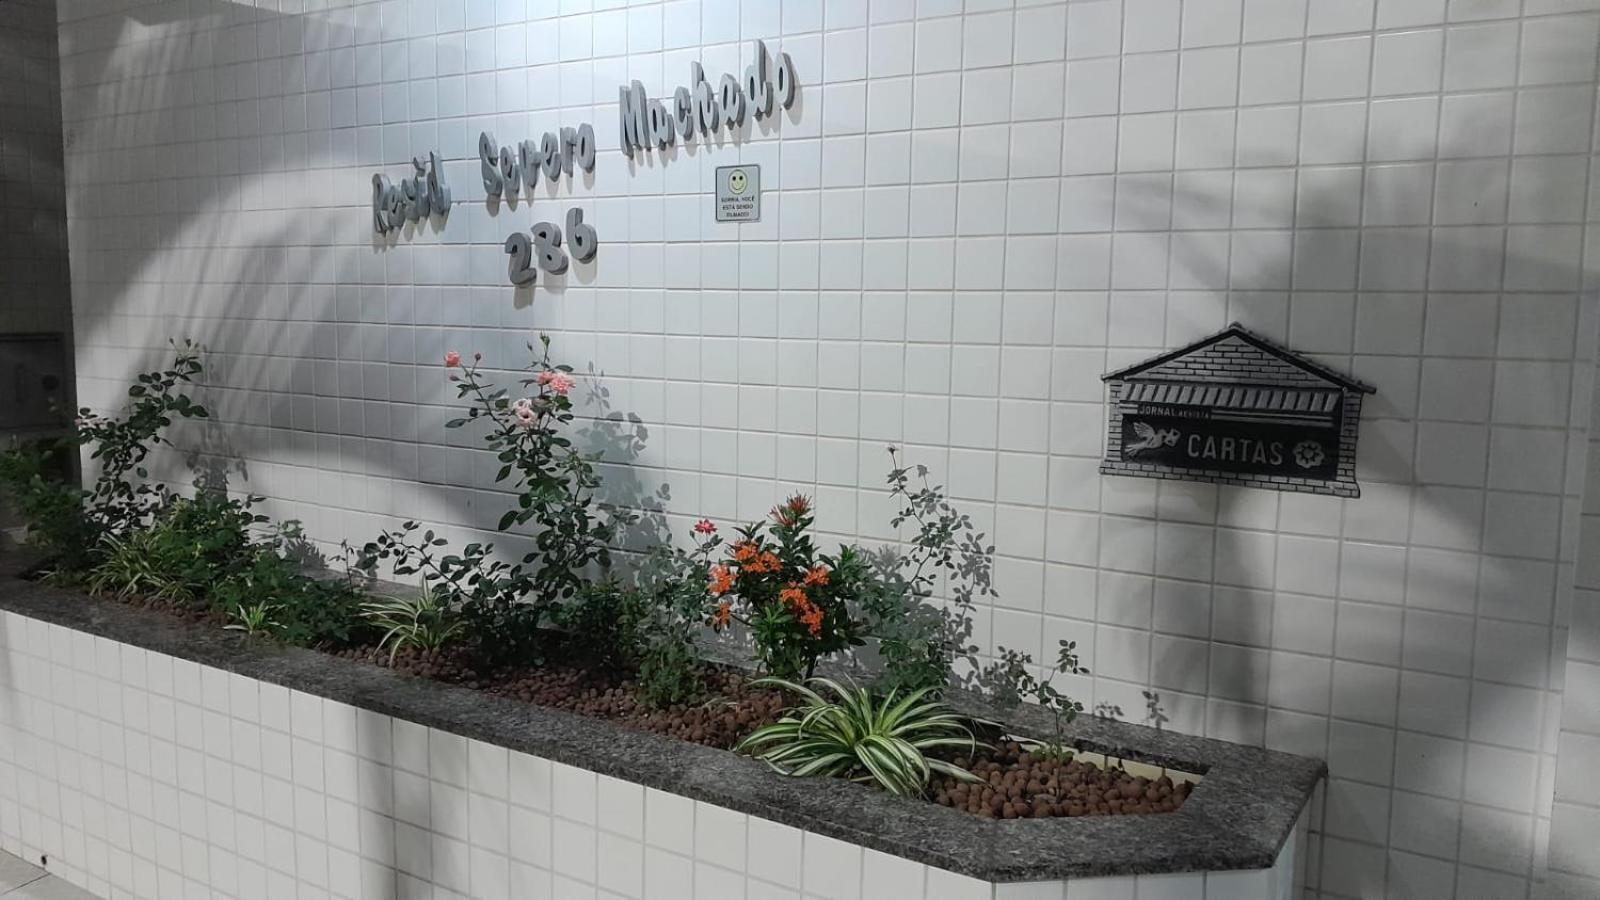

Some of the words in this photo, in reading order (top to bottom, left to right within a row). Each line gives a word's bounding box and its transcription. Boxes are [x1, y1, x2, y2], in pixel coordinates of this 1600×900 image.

[478, 123, 596, 197] Severo
[618, 39, 796, 160] Machado
[504, 208, 598, 285] 286
[1139, 405, 1176, 417] JORNAL
[1187, 434, 1283, 466] CARTAS
